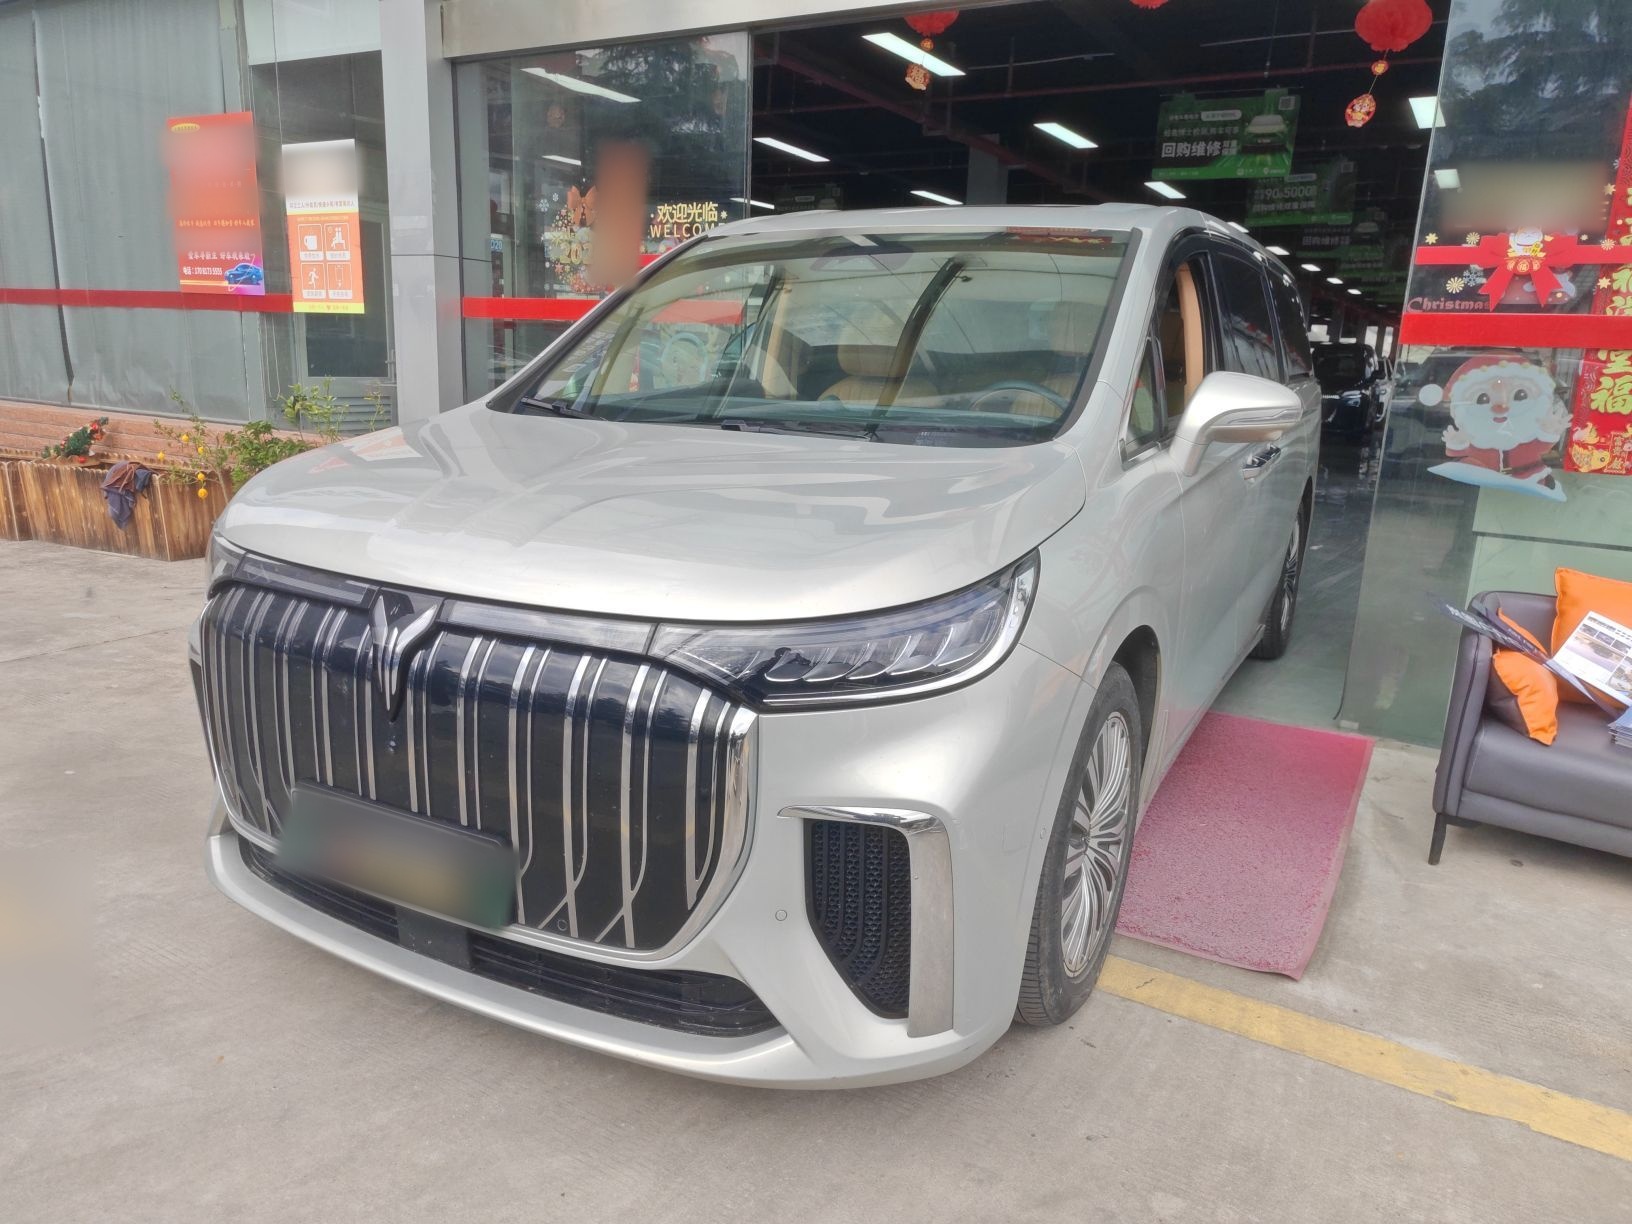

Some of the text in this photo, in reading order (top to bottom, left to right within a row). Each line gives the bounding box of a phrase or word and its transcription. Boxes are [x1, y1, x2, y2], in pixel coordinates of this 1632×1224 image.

[1162, 141, 1221, 158] 回购维修
[657, 201, 718, 223] 欢迎光临
[650, 223, 725, 238] WELCOM
